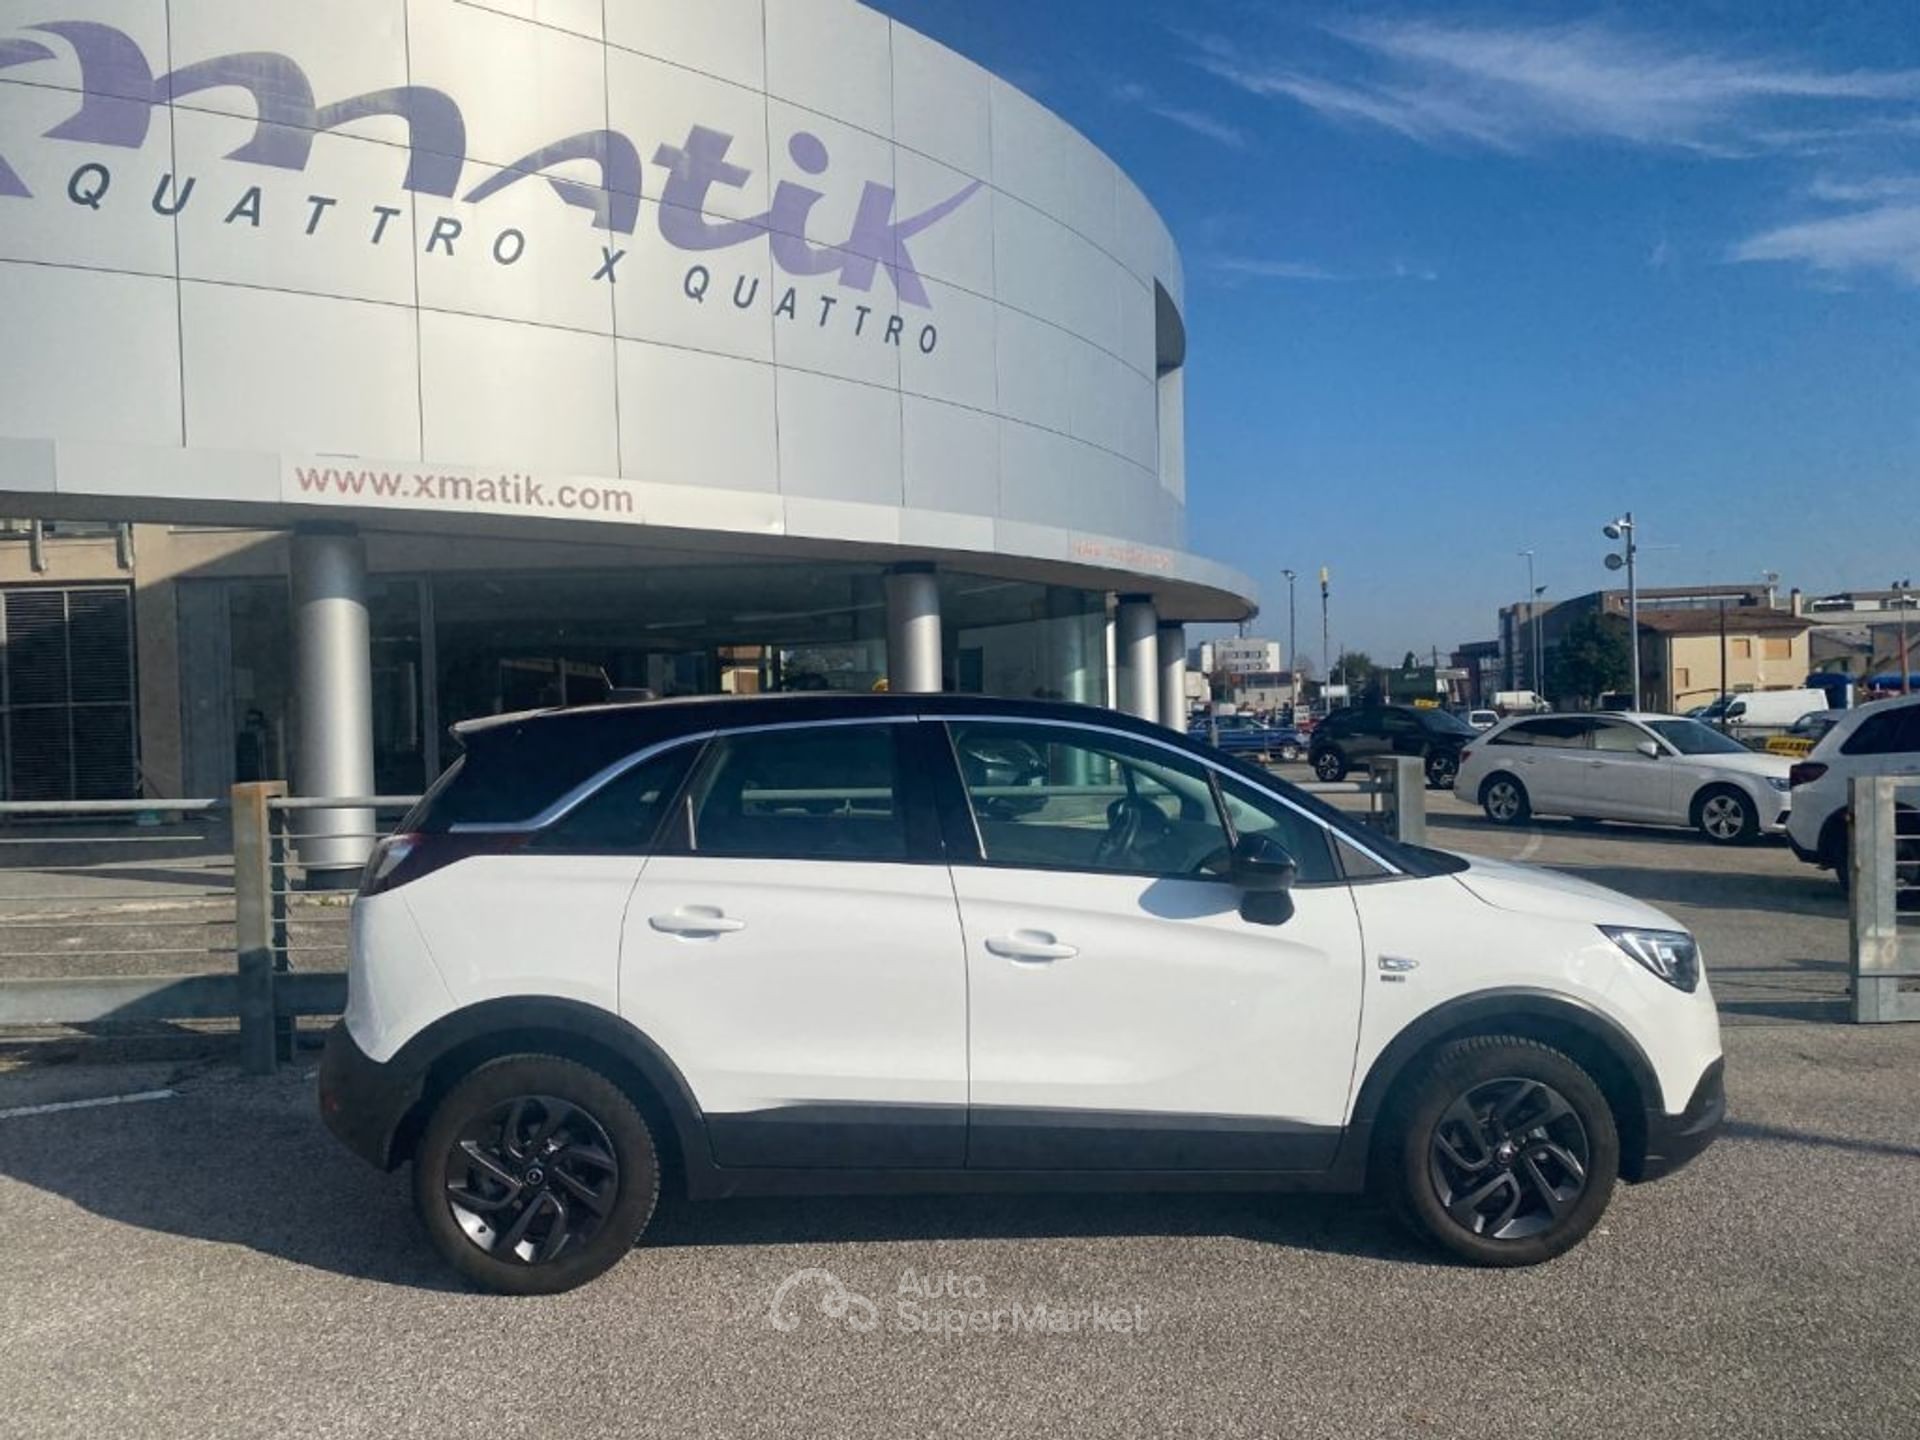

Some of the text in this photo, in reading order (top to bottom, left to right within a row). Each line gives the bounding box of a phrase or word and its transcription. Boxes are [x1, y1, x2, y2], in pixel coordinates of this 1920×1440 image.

[0, 20, 984, 309] matik
[66, 162, 938, 355] QUATTRO X QUATTRO
[295, 466, 634, 513] www.xmatik.com
